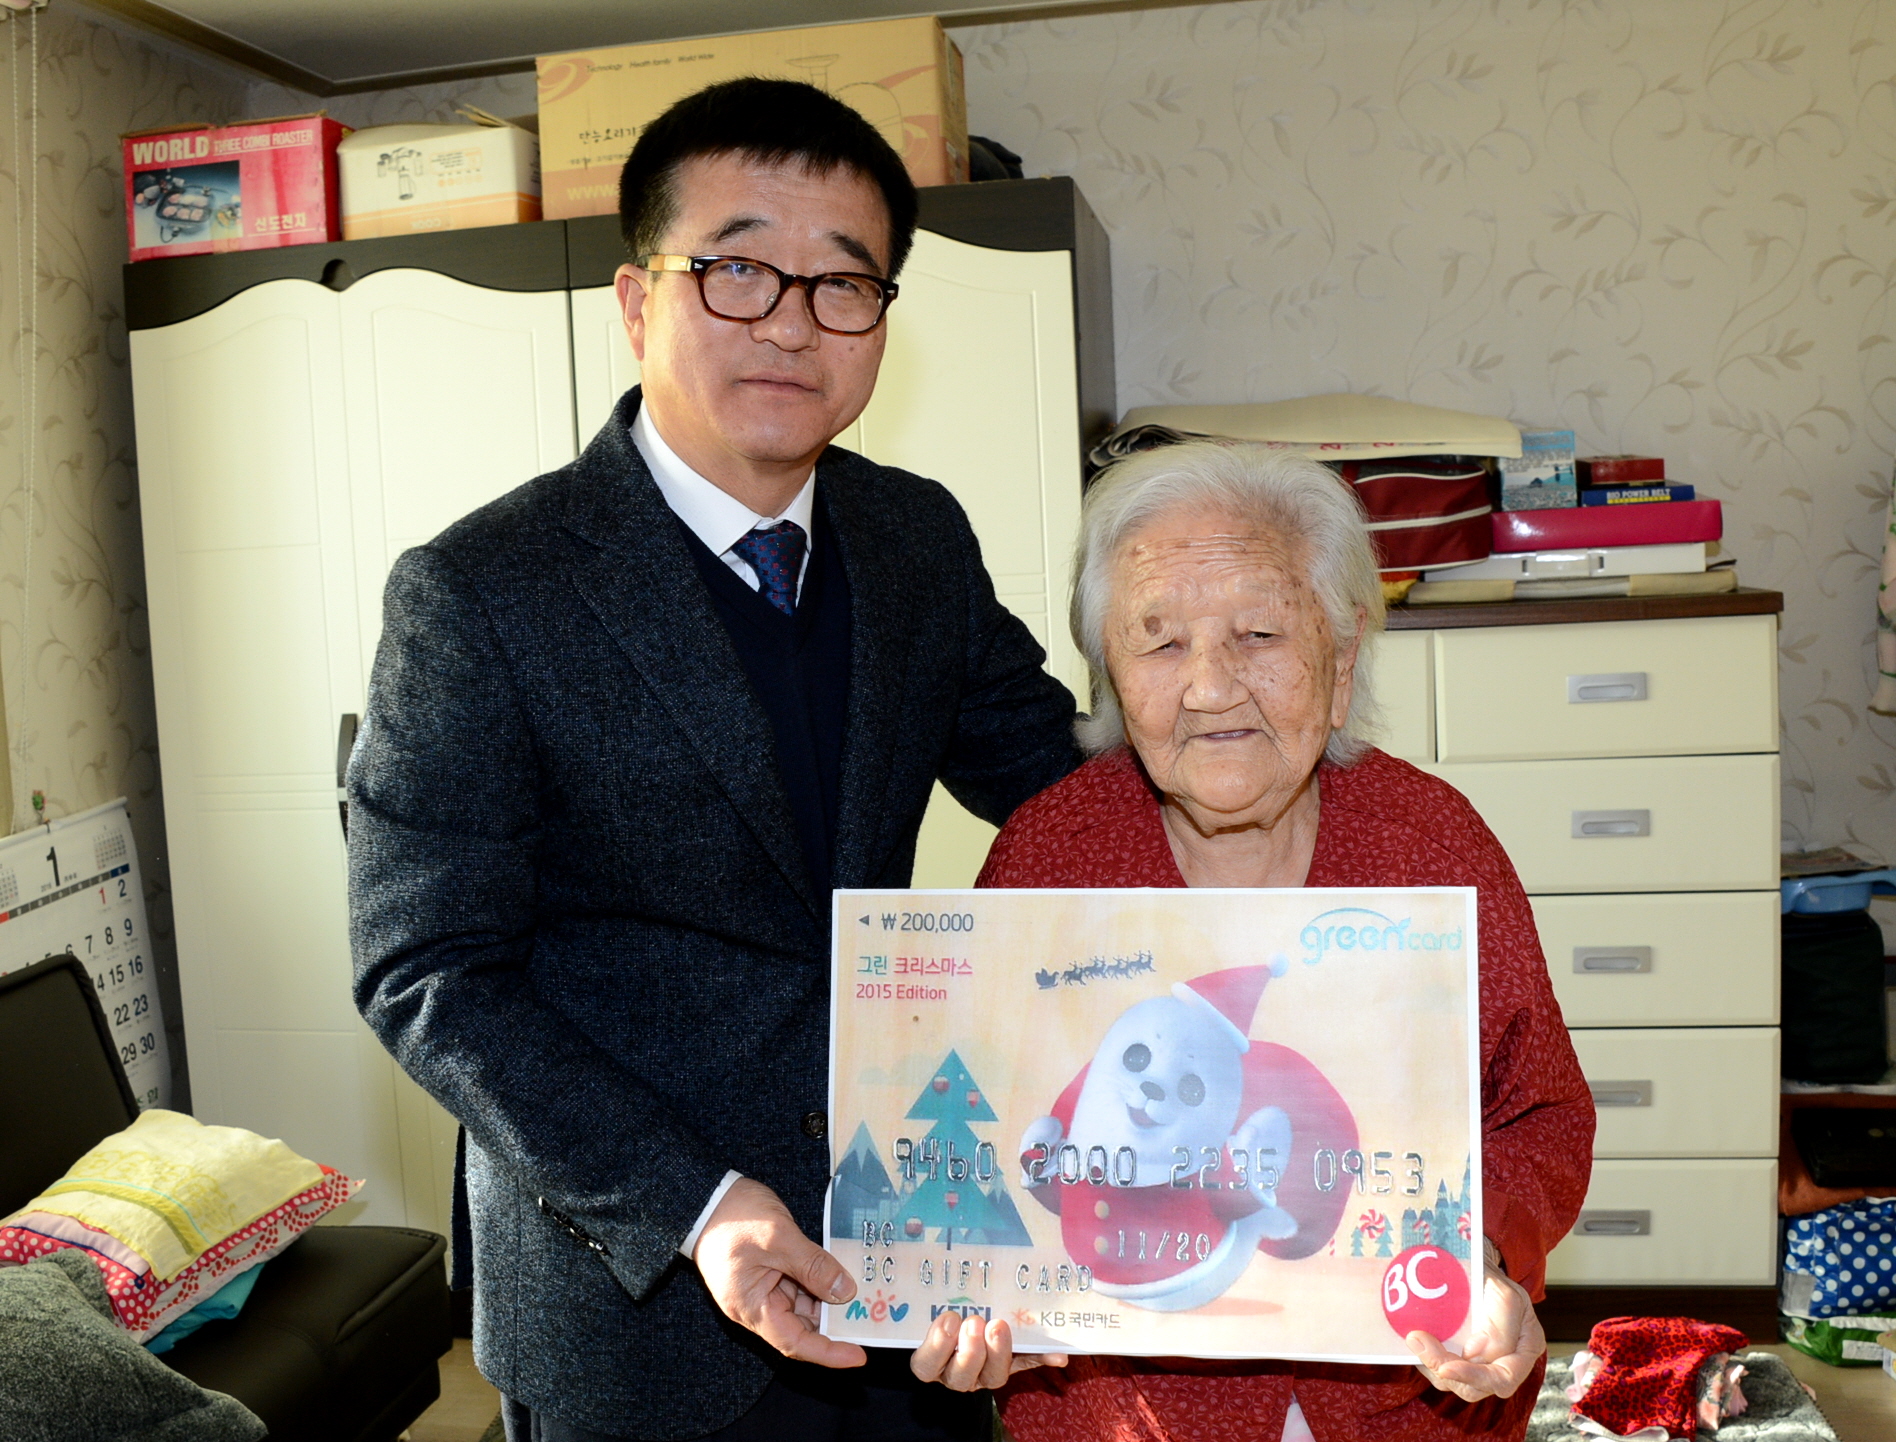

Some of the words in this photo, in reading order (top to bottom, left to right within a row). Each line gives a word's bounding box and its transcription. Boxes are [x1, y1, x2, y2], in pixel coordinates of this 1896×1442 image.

[133, 136, 210, 165] WORLD
[214, 138, 241, 153] THREE
[272, 129, 314, 145] ROASTER
[1622, 490, 1650, 498] POWER
[1651, 487, 1671, 497] BELT
[46, 846, 61, 887] 1
[99, 887, 106, 904] 1
[118, 878, 127, 897] 2
[85, 934, 93, 954] 7
[105, 926, 114, 945] 8
[124, 917, 133, 937] 9
[109, 964, 125, 986] 15
[128, 955, 144, 977] 16
[856, 955, 888, 975] 그린
[894, 956, 973, 977] 크리스마스
[856, 983, 892, 999] 2015
[896, 984, 947, 1000] Edition
[114, 1003, 131, 1026] 22
[133, 994, 149, 1017] 23
[121, 1042, 137, 1065] 29
[140, 1032, 155, 1055] 30
[893, 1137, 997, 1182] 9460
[1028, 1141, 1137, 1186] 2000
[1169, 1145, 1280, 1190] 2235
[1313, 1148, 1425, 1195] 0953
[862, 1219, 895, 1249] BC
[1117, 1229, 1212, 1262] 11/20
[862, 1255, 895, 1284] BC
[919, 1258, 993, 1291] GIFT
[1015, 1262, 1094, 1293] CARD
[1384, 1249, 1449, 1313] BC
[1040, 1311, 1066, 1327] KB
[1068, 1311, 1122, 1329] 국민카드
